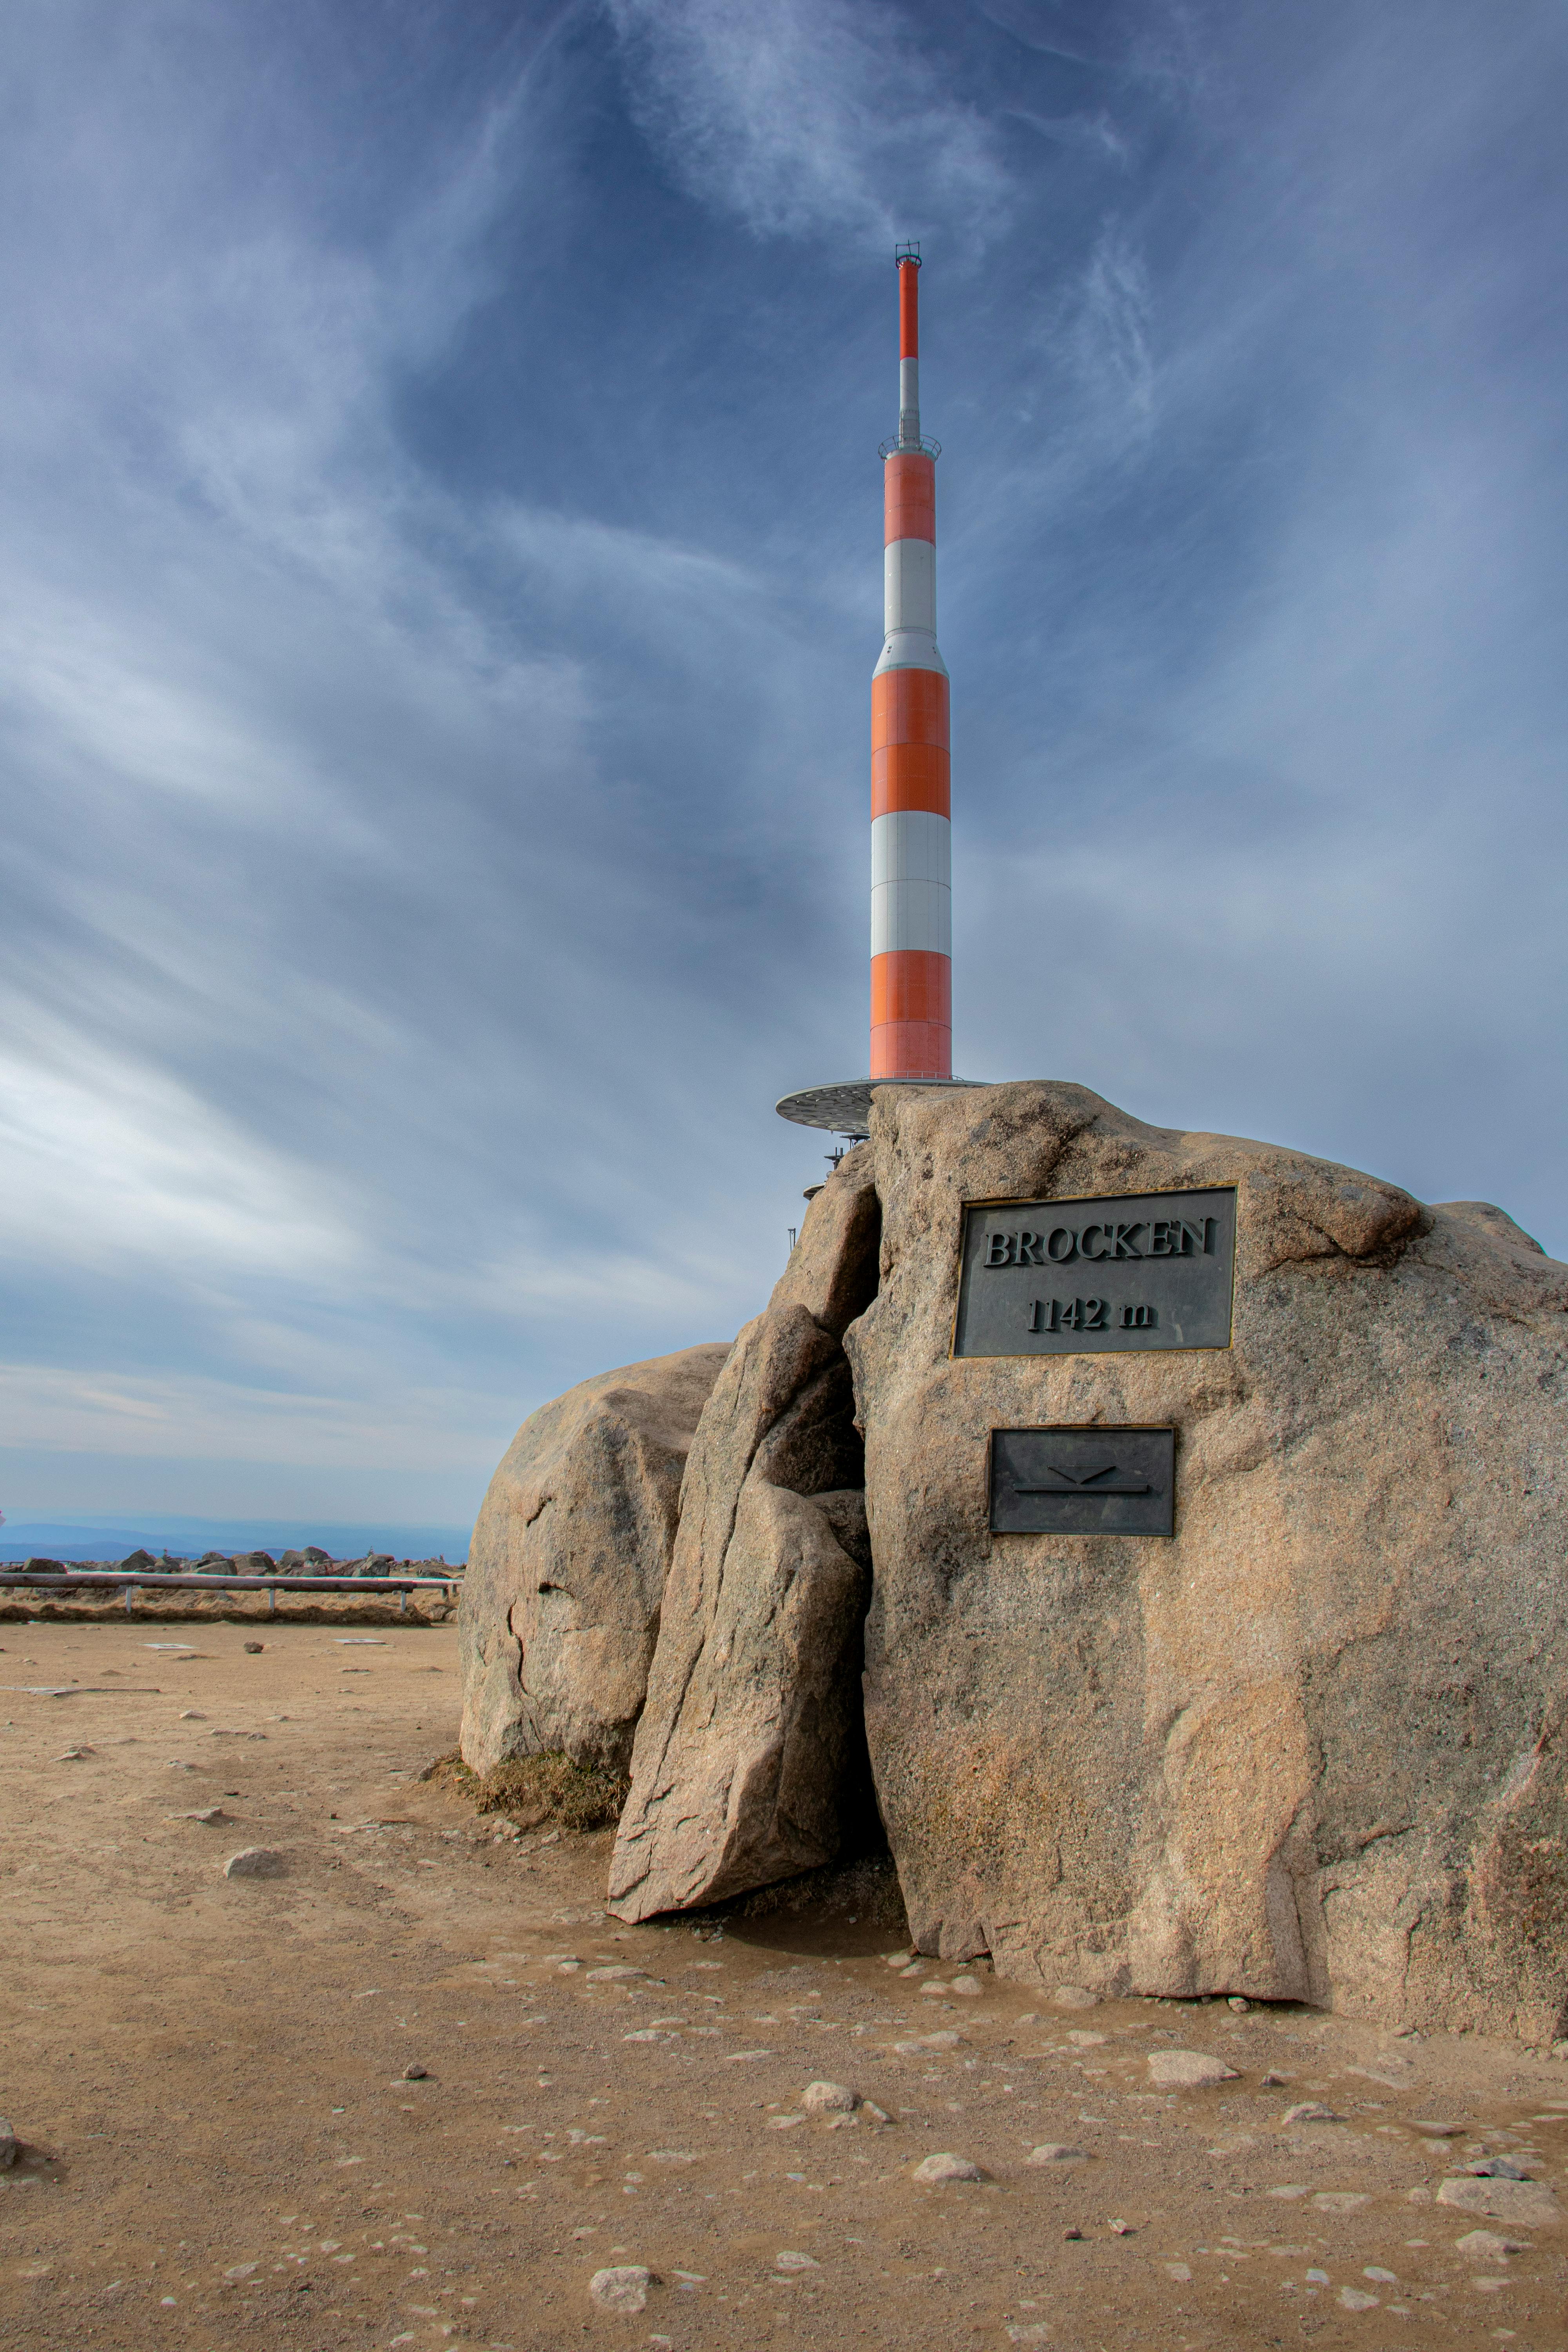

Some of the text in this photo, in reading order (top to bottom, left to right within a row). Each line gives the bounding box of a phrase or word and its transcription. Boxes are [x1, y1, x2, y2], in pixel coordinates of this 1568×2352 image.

[983, 1217, 1212, 1267] BROCKEN
[1027, 1298, 1152, 1331] 1142 m
